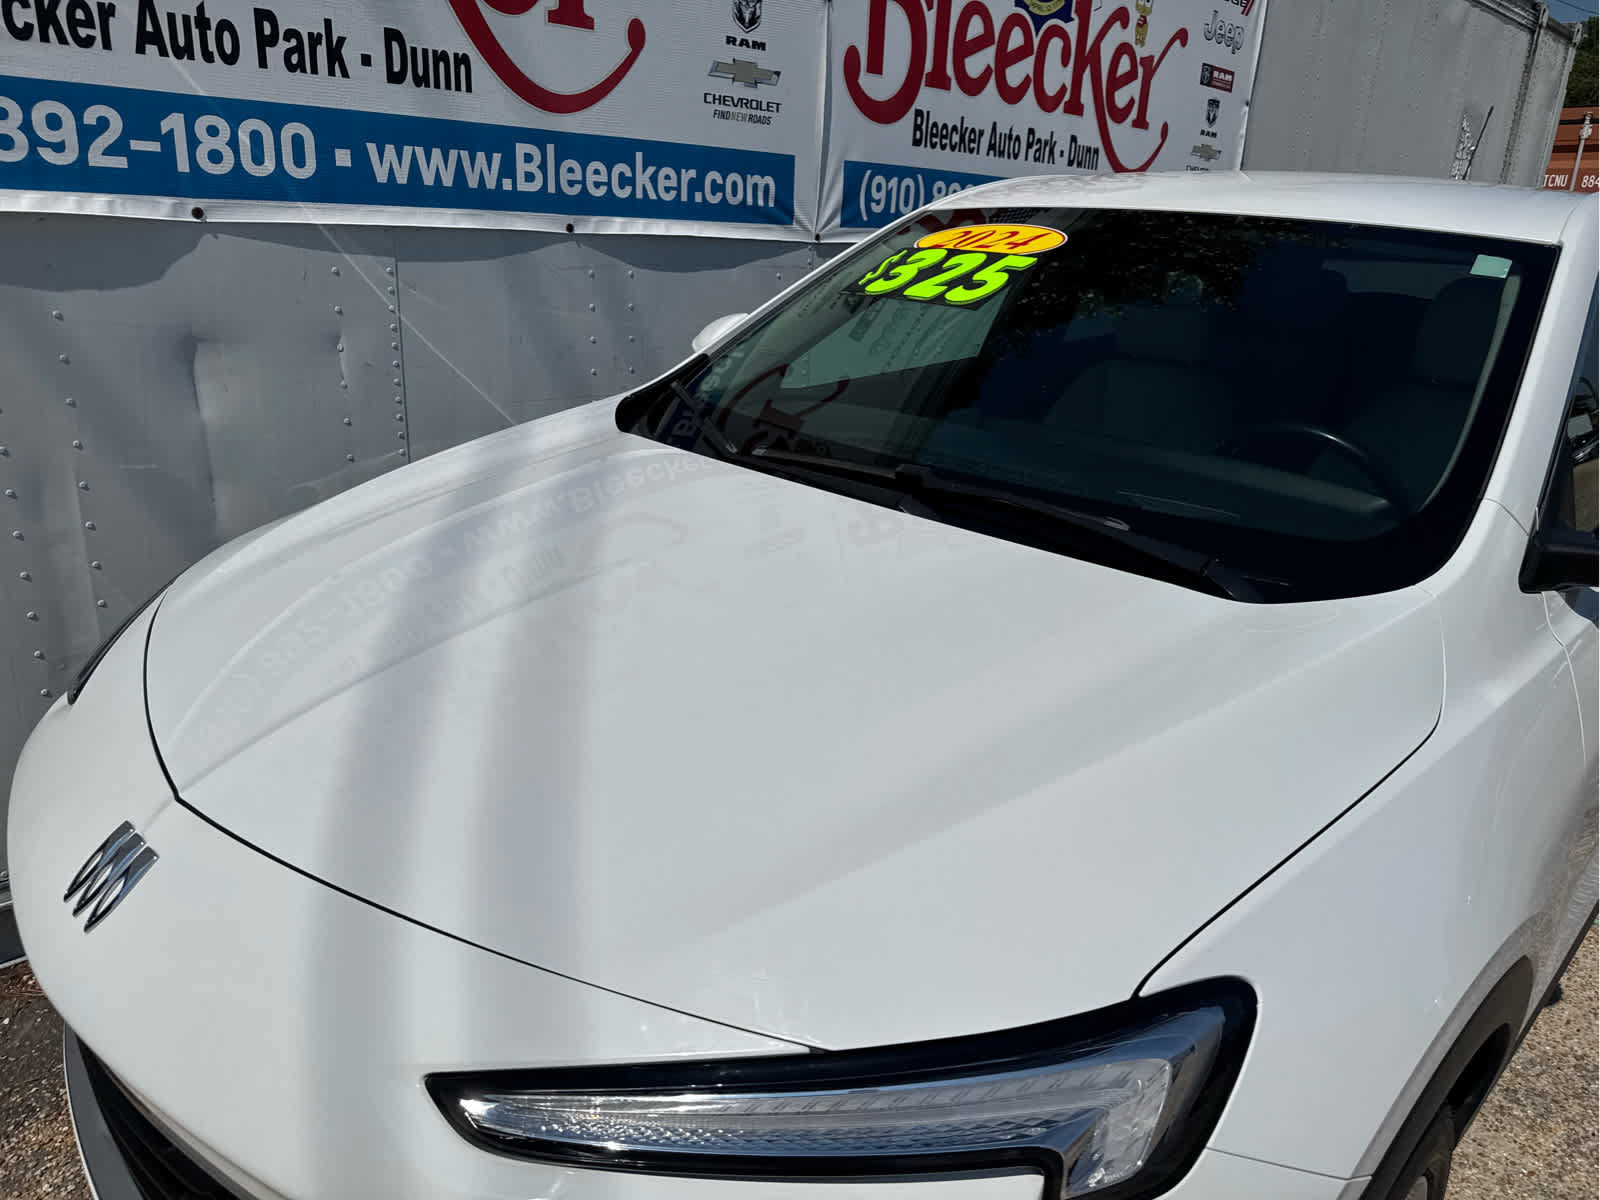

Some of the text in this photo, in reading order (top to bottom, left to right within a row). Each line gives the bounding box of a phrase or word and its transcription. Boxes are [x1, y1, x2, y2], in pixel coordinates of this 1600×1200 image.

[135, 0, 241, 66] Auto
[253, 7, 351, 80] Park
[384, 26, 473, 93] Dunn
[725, 34, 767, 51] RAM
[1203, 10, 1245, 54] Jeep
[1212, 70, 1233, 82] RAM
[703, 92, 783, 114] CHEVROLET
[911, 108, 985, 156] Bleecker
[986, 120, 1022, 161] Auto
[1024, 127, 1057, 165] Park
[1066, 134, 1100, 171] Dunn
[1199, 128, 1218, 139] RAM
[365, 141, 776, 208] www.Bleecker.com
[859, 169, 926, 222] (910)
[931, 229, 1053, 250] 2024
[858, 248, 1039, 305] $325
